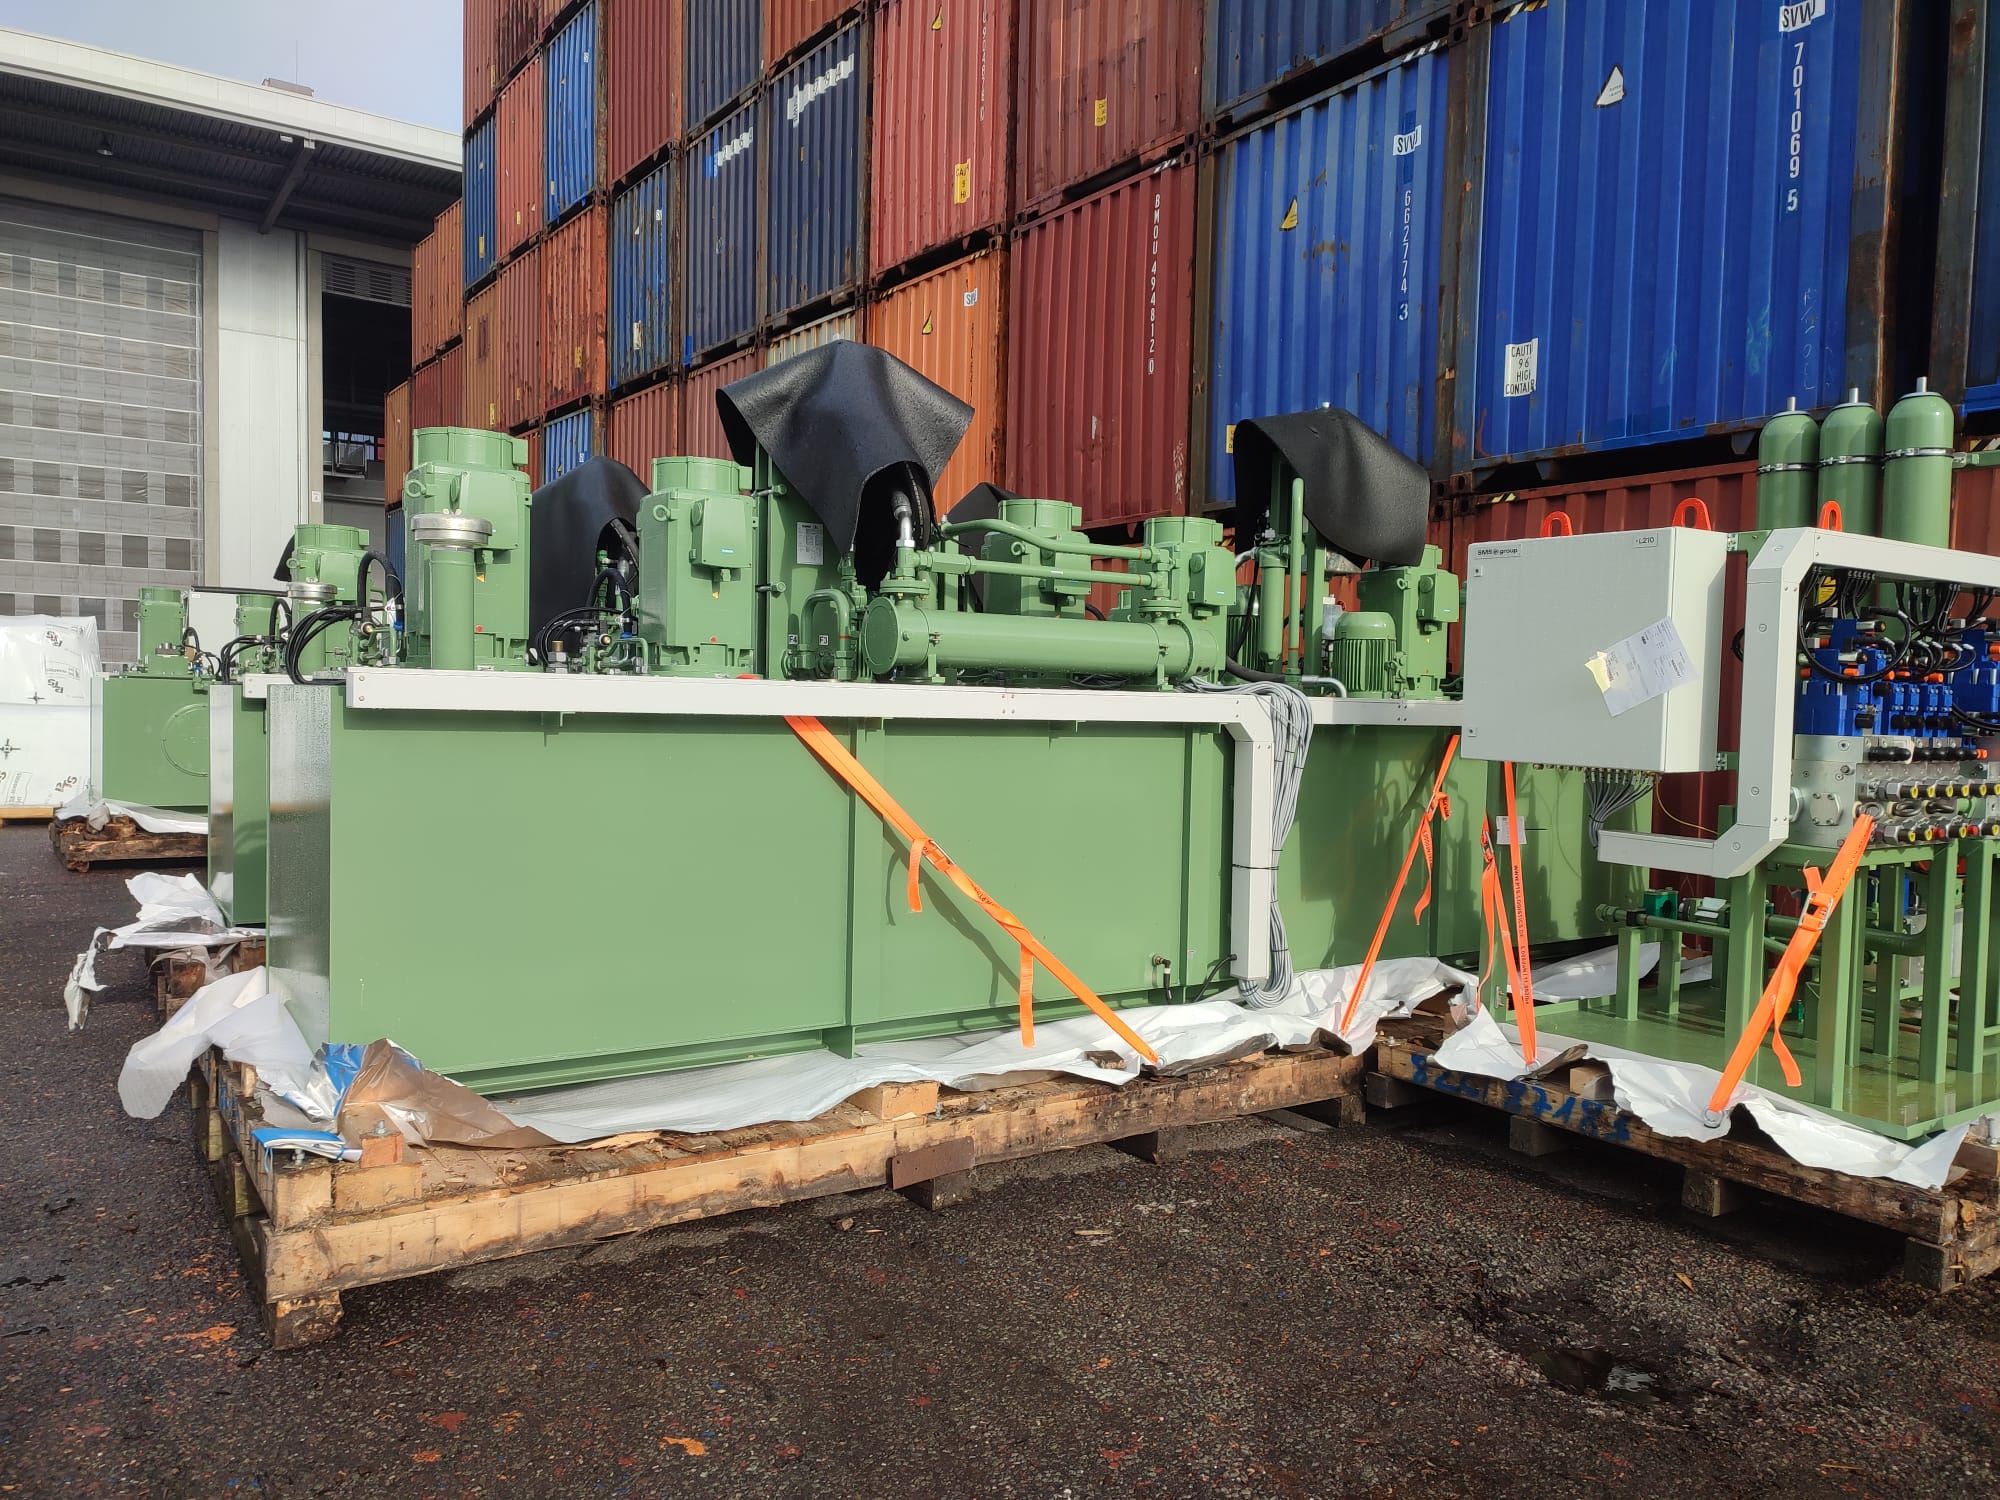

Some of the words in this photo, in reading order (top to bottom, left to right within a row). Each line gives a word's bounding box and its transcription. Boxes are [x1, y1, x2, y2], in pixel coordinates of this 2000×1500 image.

[1789, 41, 1804, 178] 701069
[1152, 194, 1160, 256] BMOU
[1787, 188, 1798, 212] 5
[1400, 189, 1411, 294] 662774
[1399, 303, 1409, 321] 3
